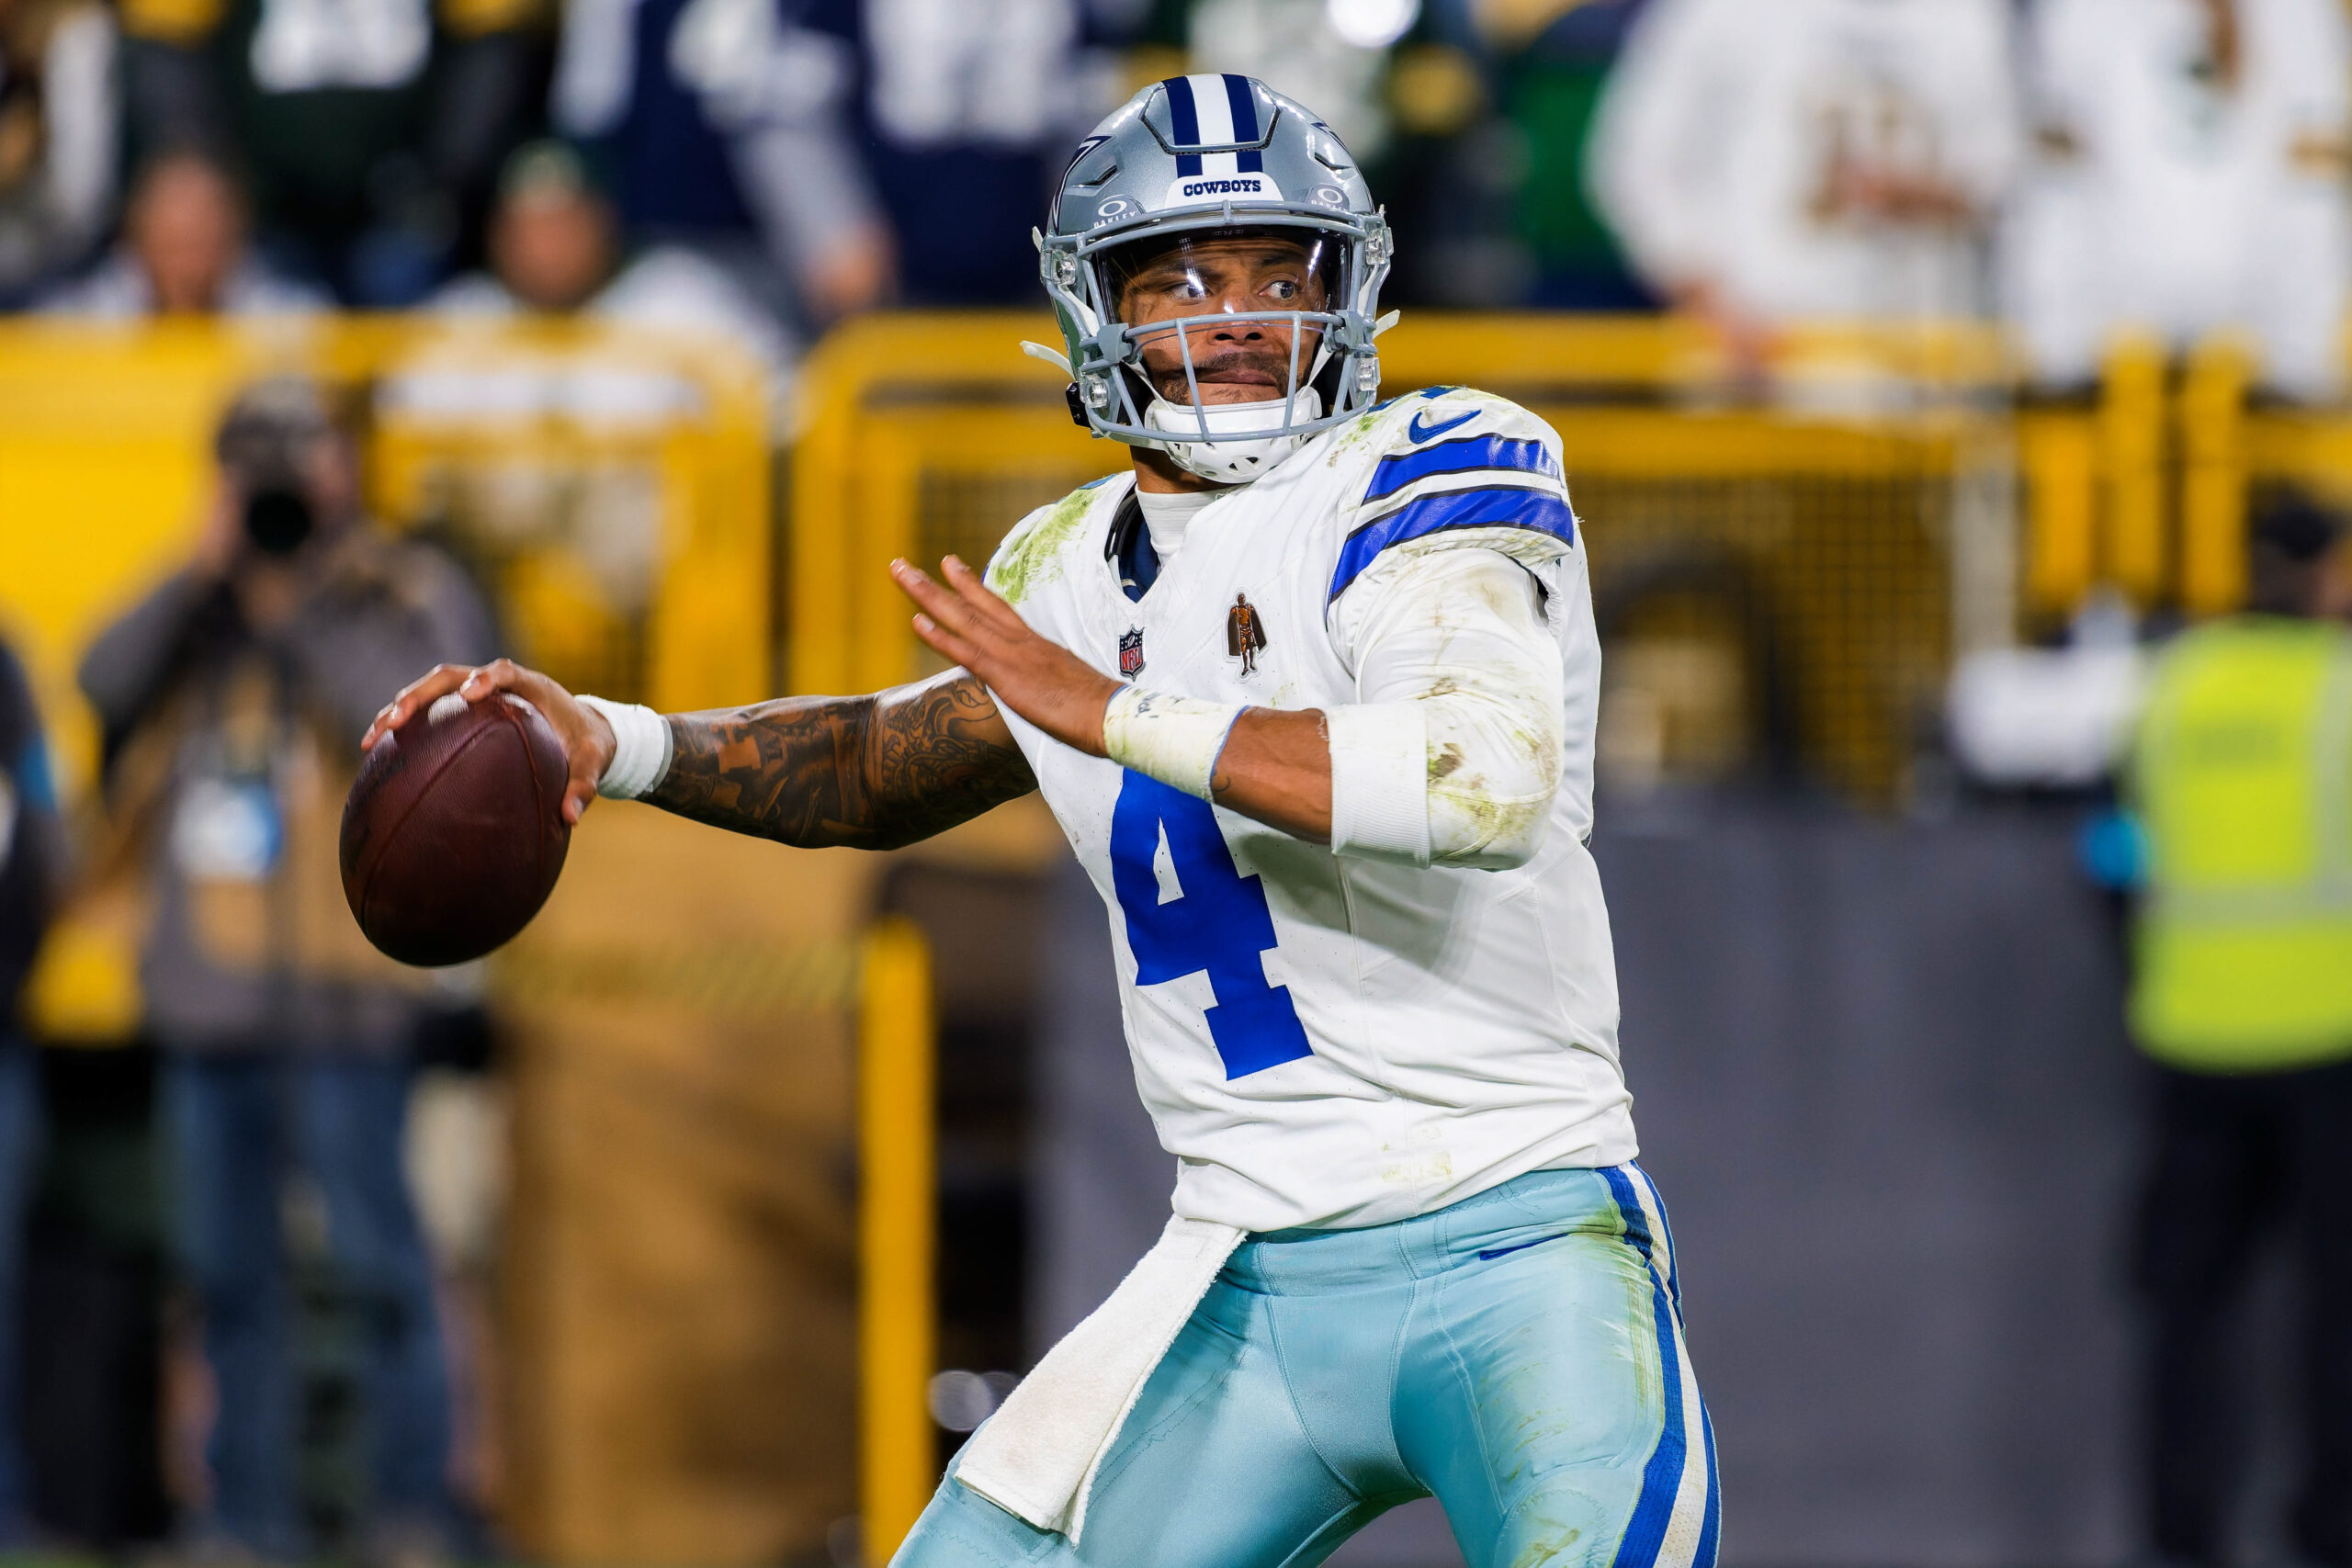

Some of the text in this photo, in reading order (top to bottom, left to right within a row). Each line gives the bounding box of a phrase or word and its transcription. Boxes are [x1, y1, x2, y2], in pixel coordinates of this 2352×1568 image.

[1183, 179, 1261, 197] COWBOYS
[1121, 647, 1142, 671] NFL
[1110, 766, 1315, 1081] 4
